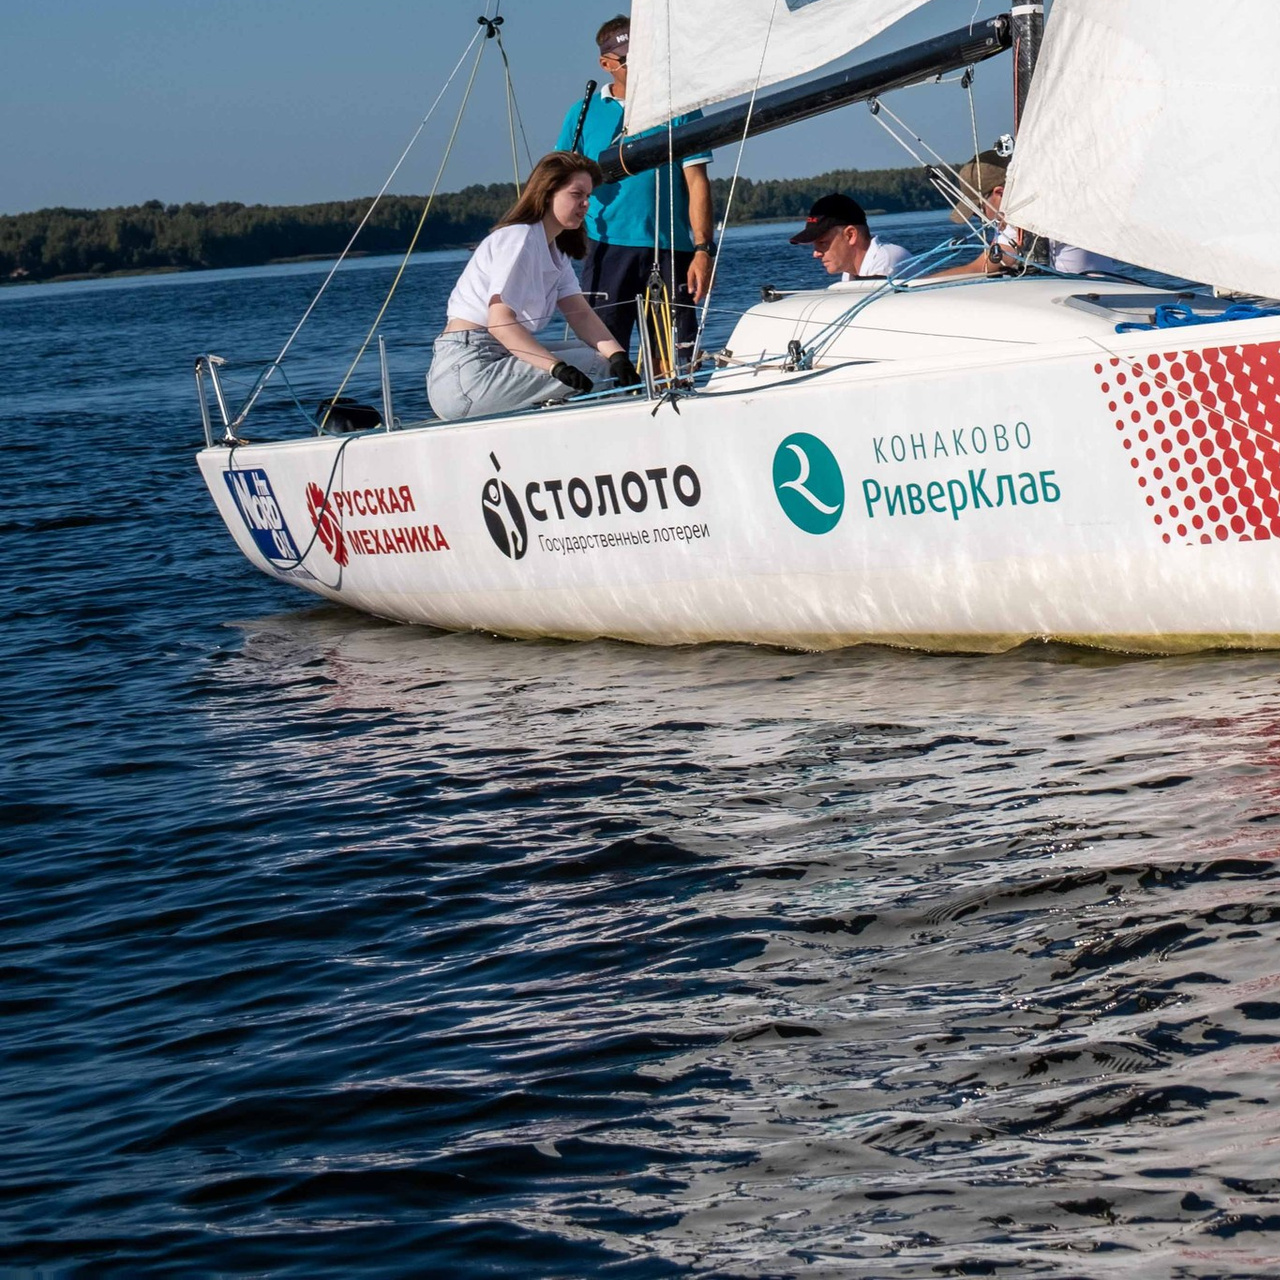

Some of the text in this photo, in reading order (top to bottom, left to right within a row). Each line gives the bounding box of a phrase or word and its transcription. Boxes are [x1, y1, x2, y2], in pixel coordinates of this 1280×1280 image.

[873, 421, 1032, 464] КОНАКОВО
[228, 472, 283, 530] NORD
[333, 485, 416, 517] РУССКАЯ
[525, 464, 702, 522] СТОЛОТО
[861, 468, 1062, 521] РиверКлаб
[346, 524, 451, 556] МЕХАНИКА
[538, 523, 711, 555] Государственные лотереи
